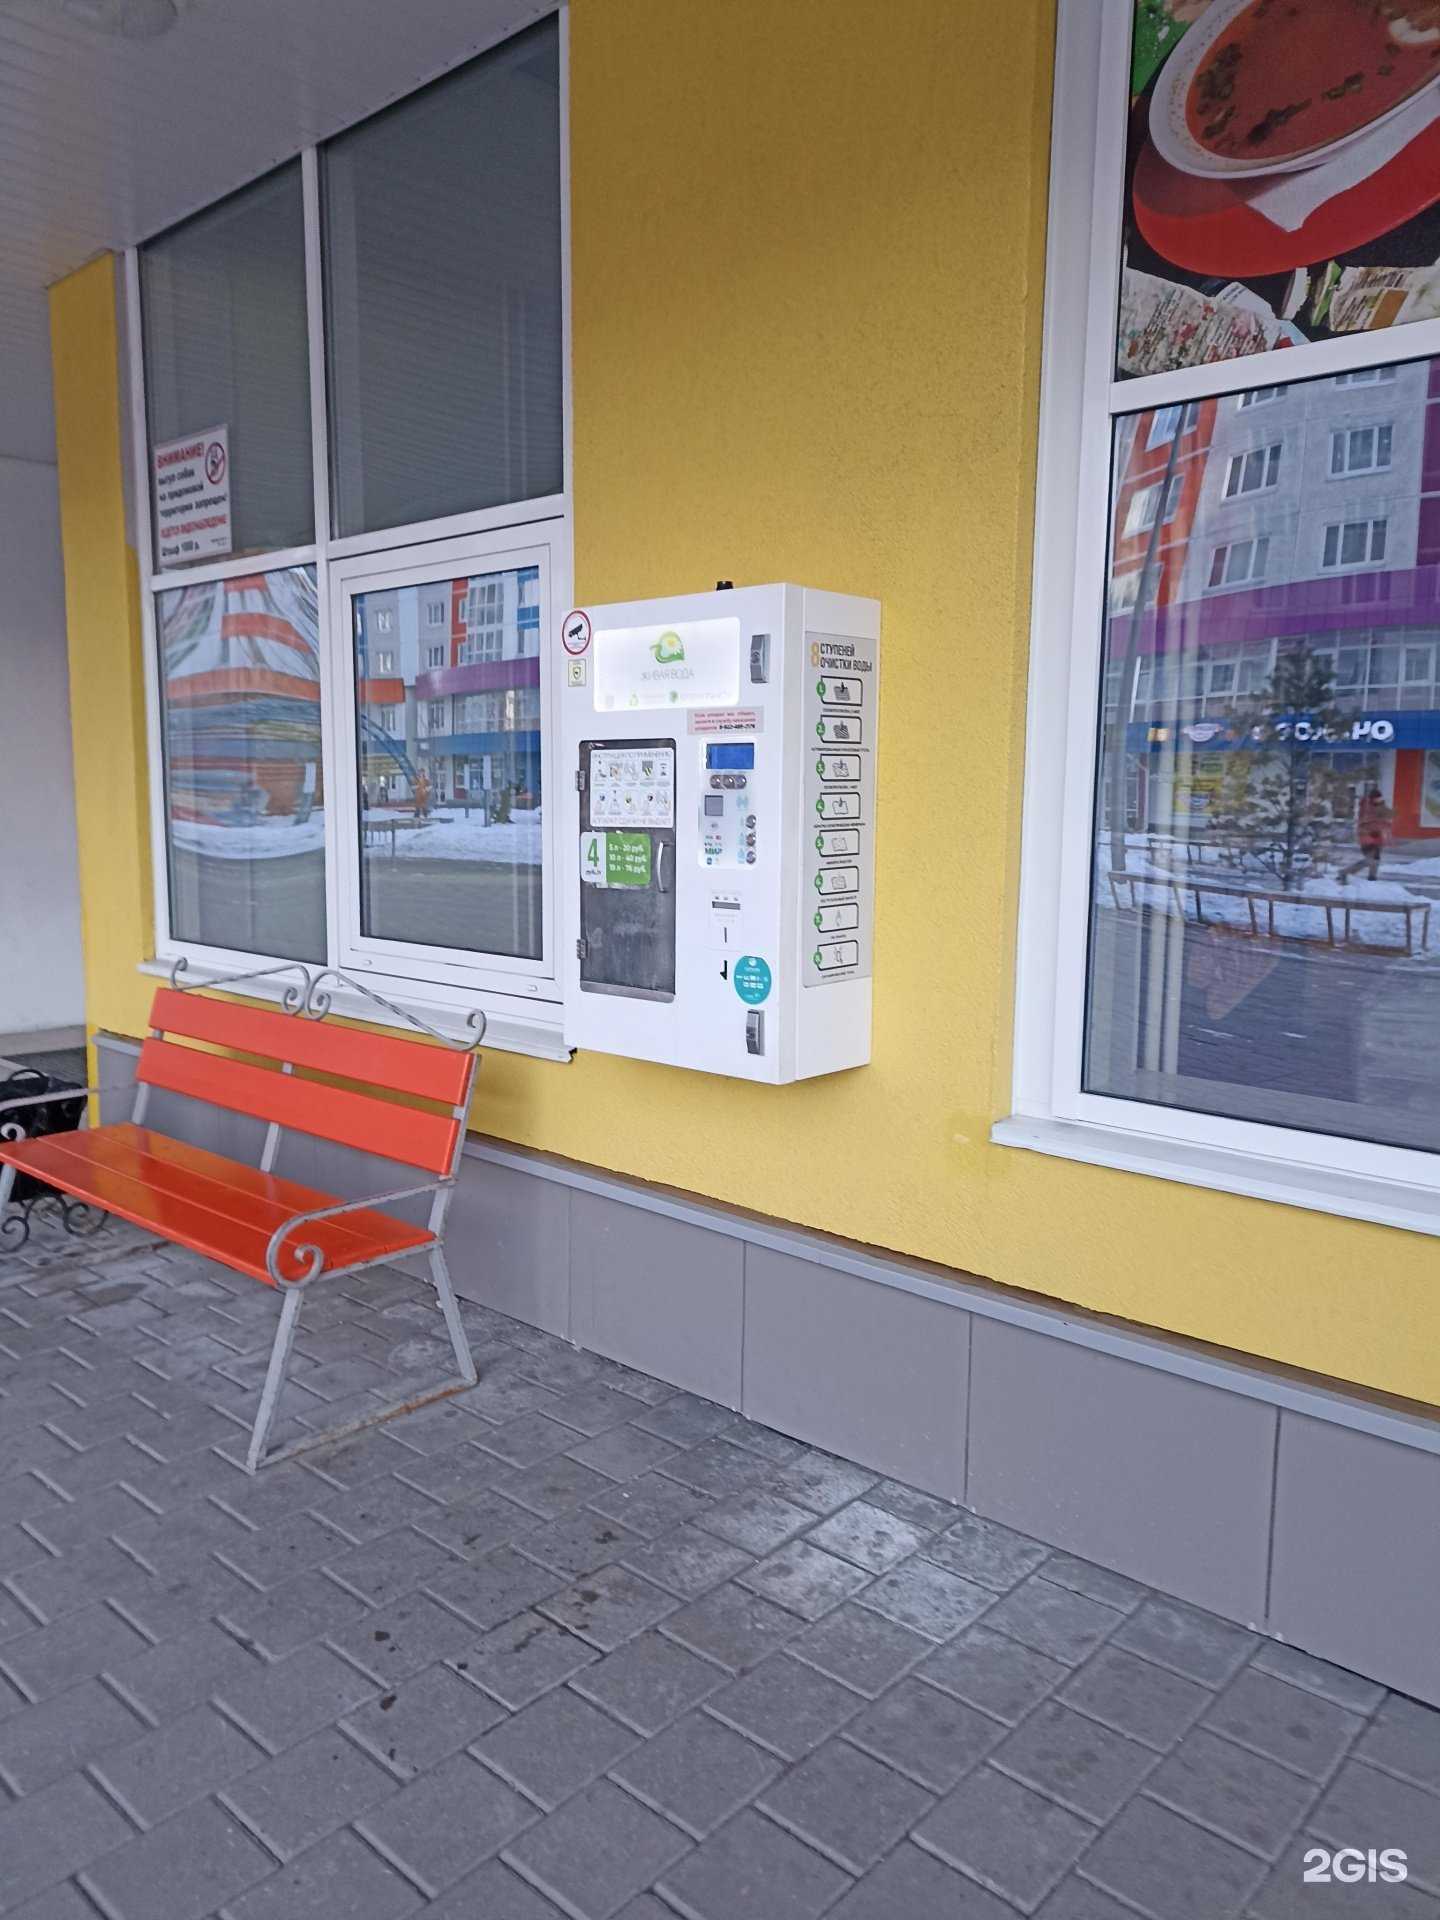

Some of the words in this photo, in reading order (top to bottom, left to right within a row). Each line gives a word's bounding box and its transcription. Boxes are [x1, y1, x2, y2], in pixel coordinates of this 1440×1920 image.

[820, 643, 855, 657] СТУПЕНЕЙ
[820, 657, 852, 670] ОЧИСТКИ
[853, 660, 872, 672] ВОДЫ
[671, 667, 695, 679] ВОДА
[587, 838, 600, 867] 4
